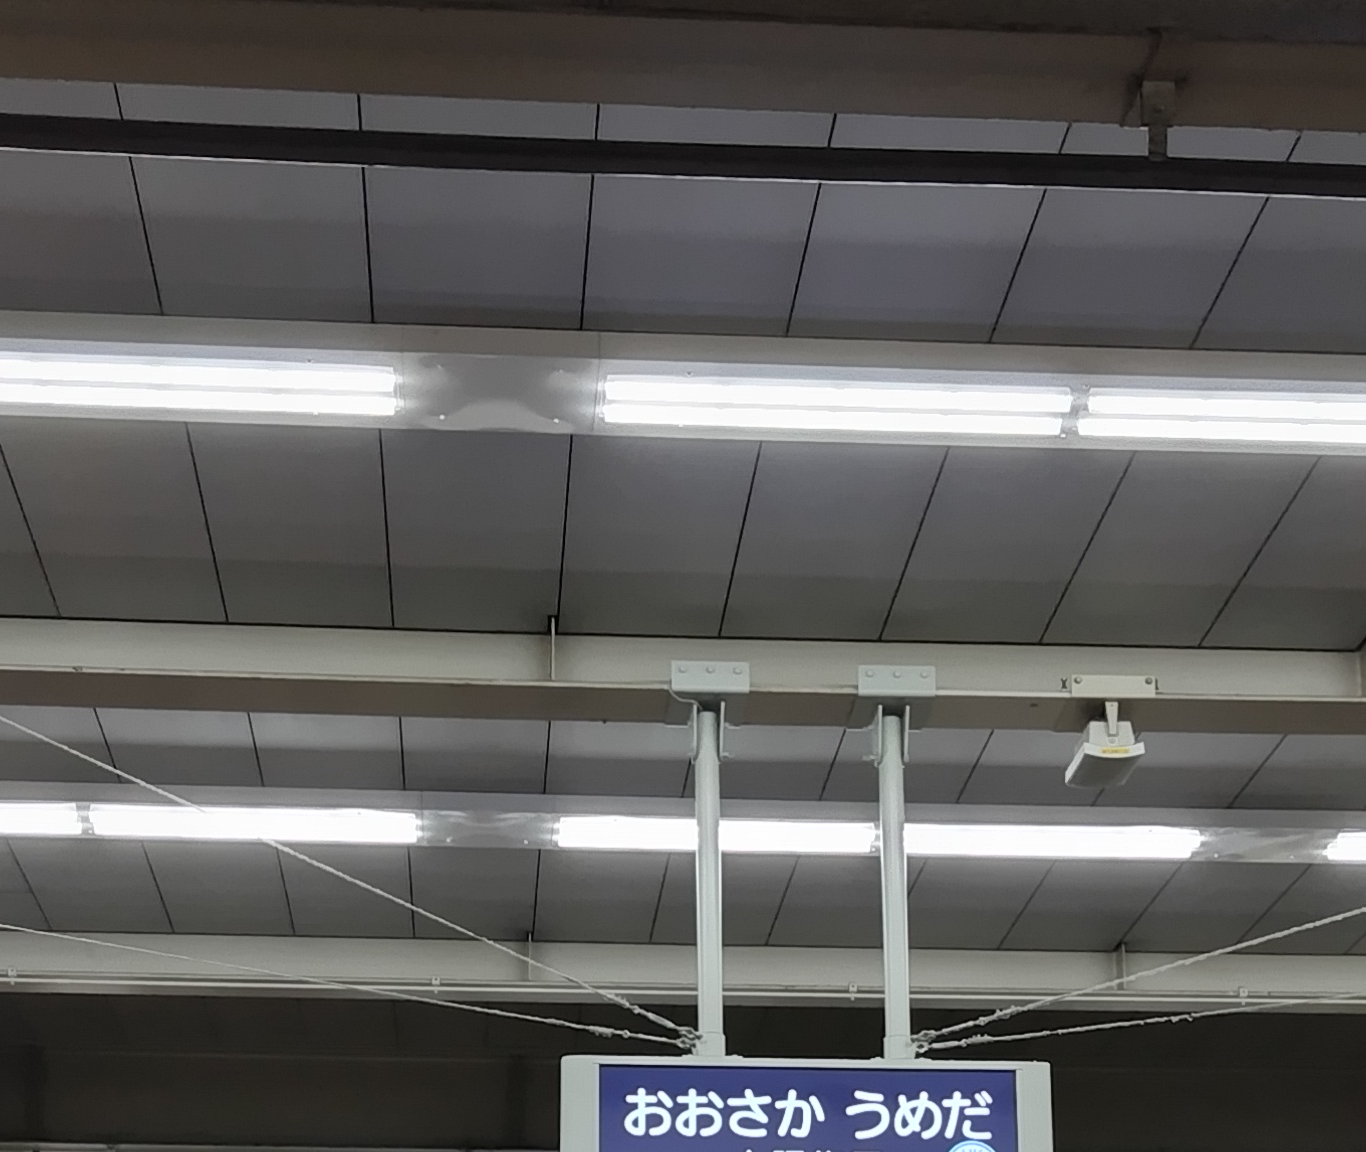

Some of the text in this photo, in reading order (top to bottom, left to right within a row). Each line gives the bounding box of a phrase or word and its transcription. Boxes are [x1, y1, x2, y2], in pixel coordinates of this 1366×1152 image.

[623, 1088, 994, 1140] おおさか うめだ
